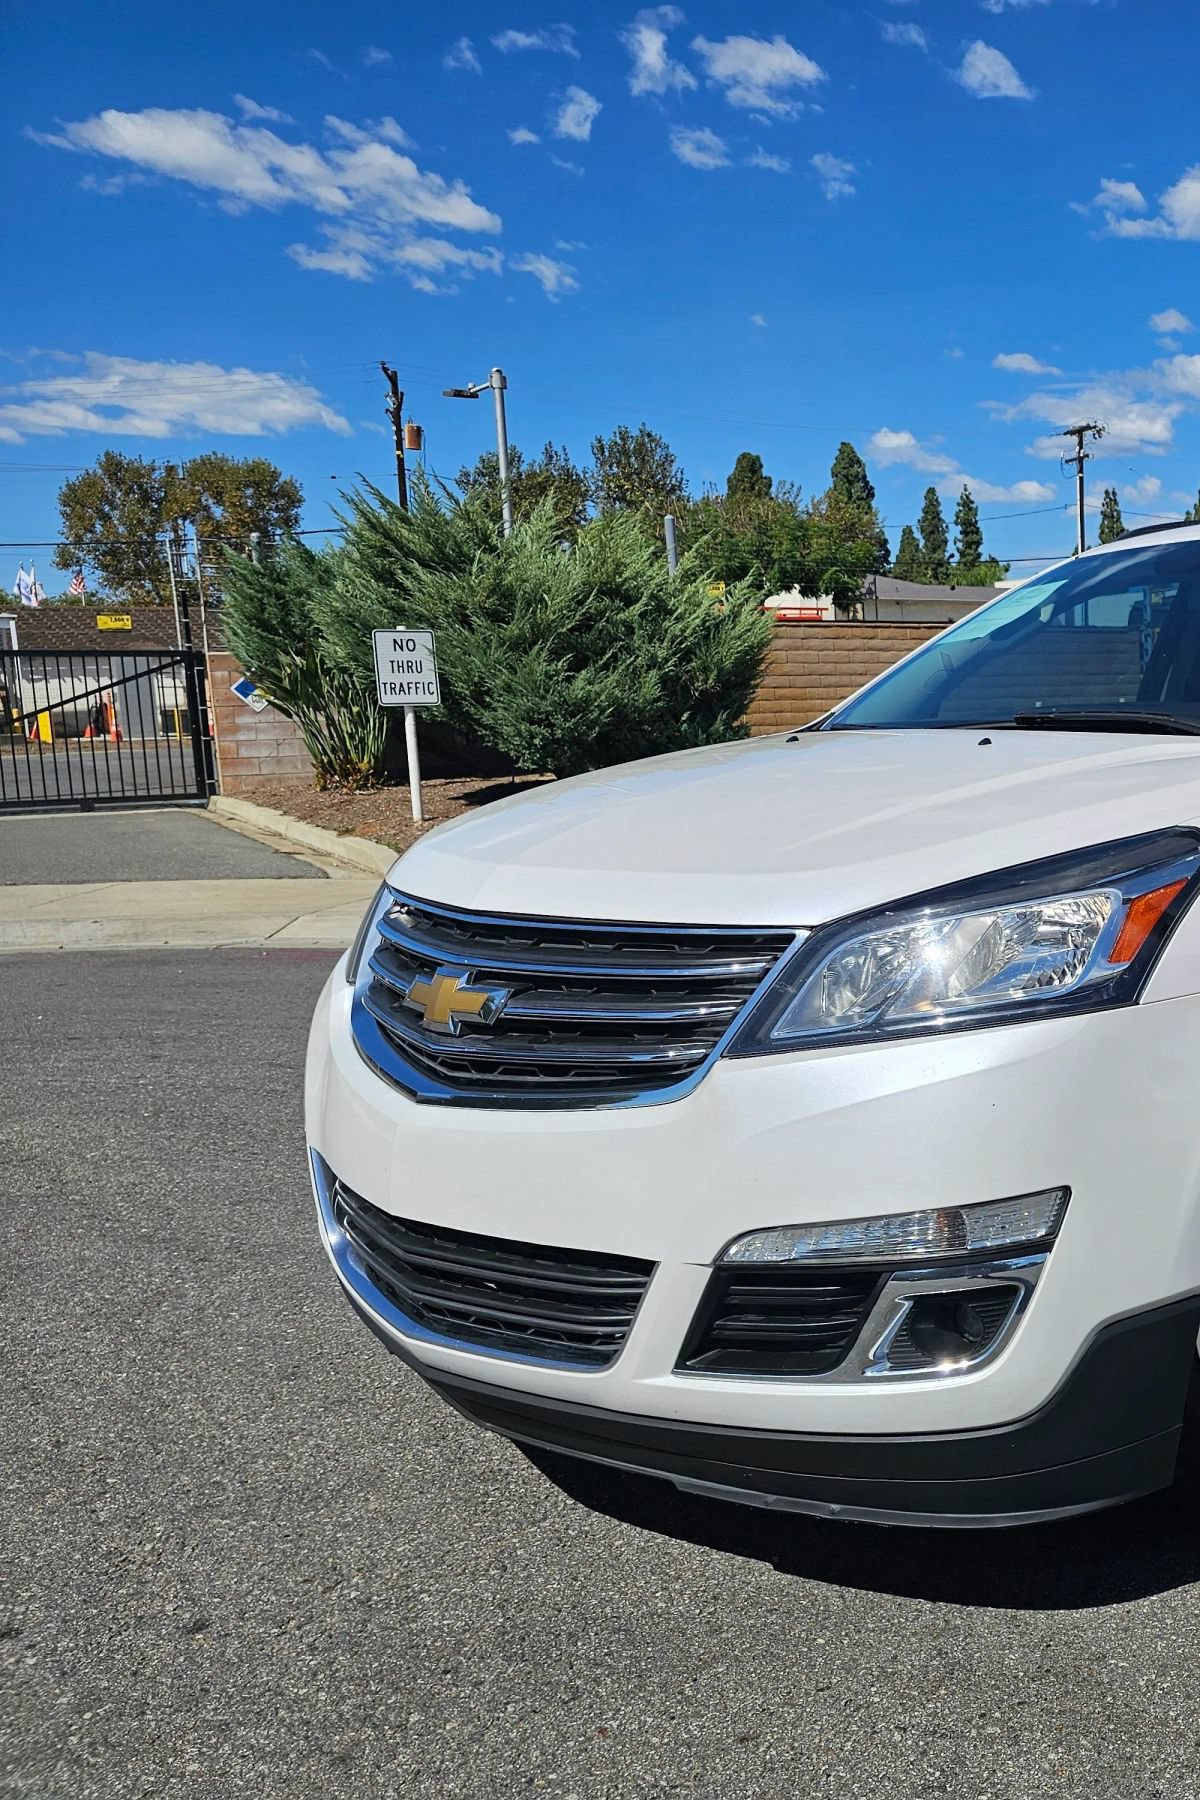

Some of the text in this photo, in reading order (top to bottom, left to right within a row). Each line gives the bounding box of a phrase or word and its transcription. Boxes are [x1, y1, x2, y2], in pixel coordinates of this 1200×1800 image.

[393, 638, 416, 652] NO
[389, 660, 423, 674] THRU
[381, 681, 435, 696] TRAFFIC
